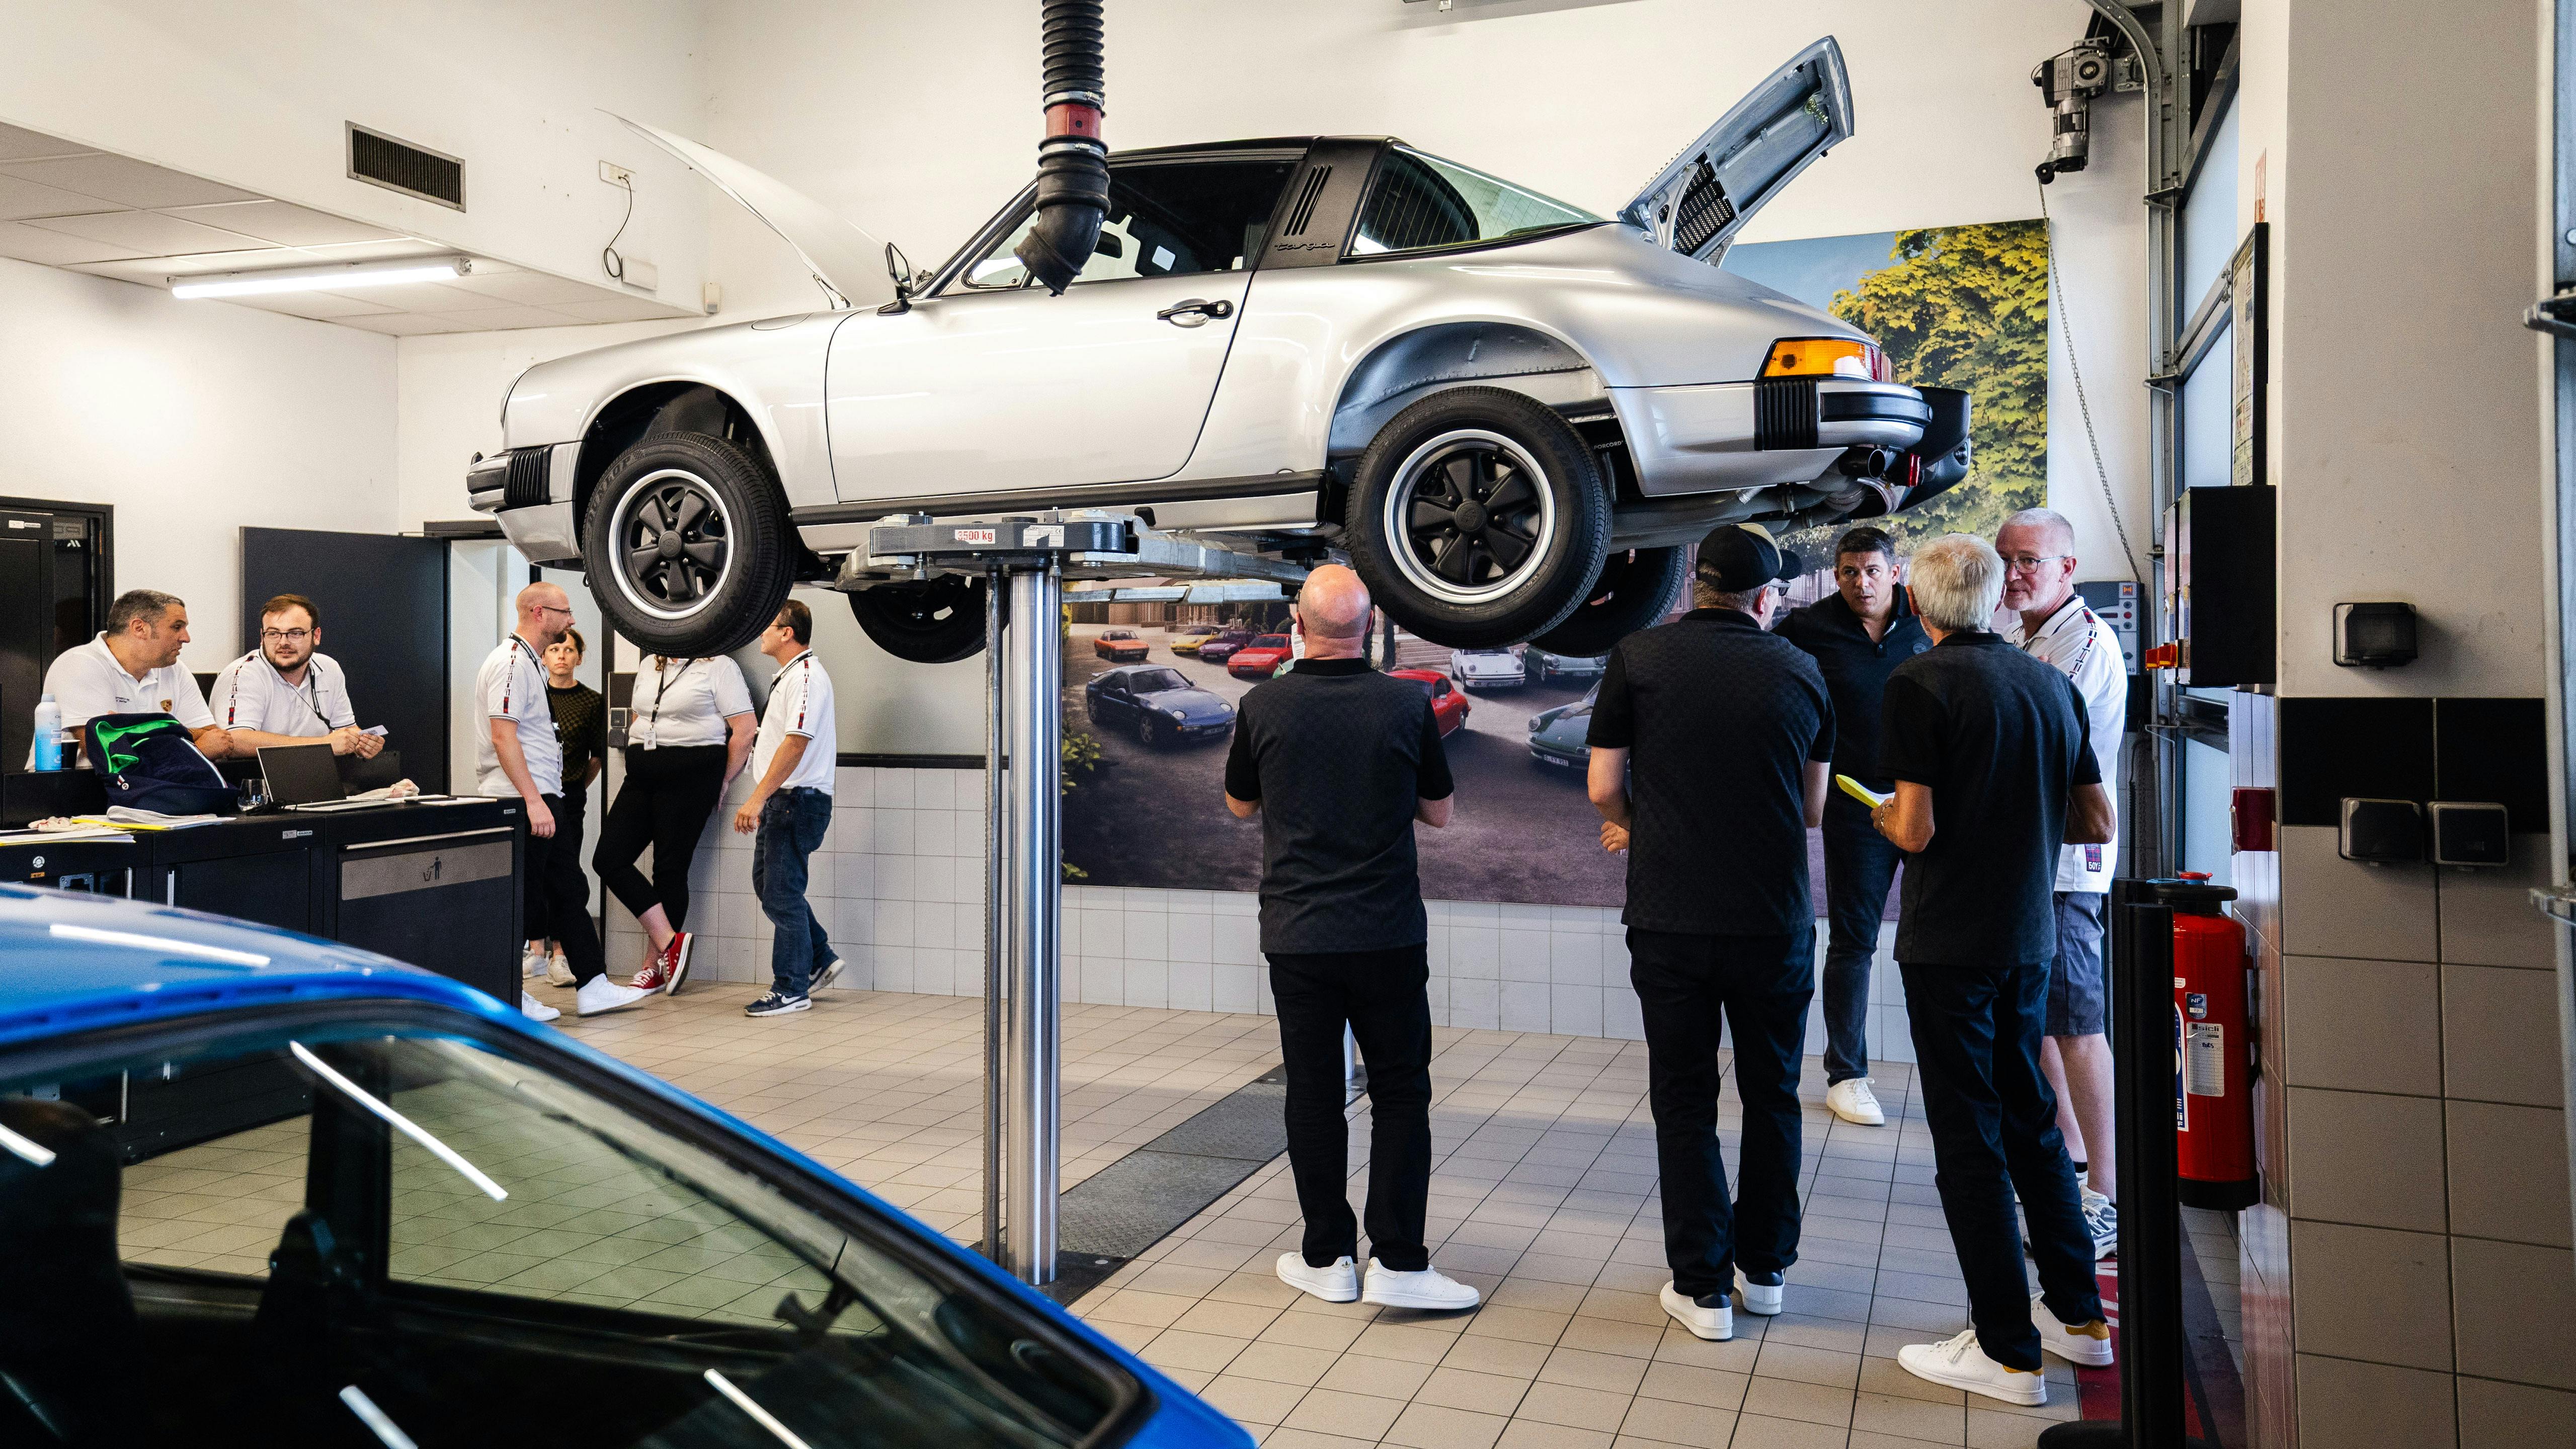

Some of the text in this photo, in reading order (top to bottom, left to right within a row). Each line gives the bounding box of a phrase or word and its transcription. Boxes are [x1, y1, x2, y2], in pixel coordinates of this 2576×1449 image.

[1274, 242, 1336, 251] targa
[957, 530, 993, 542] 3500 kg
